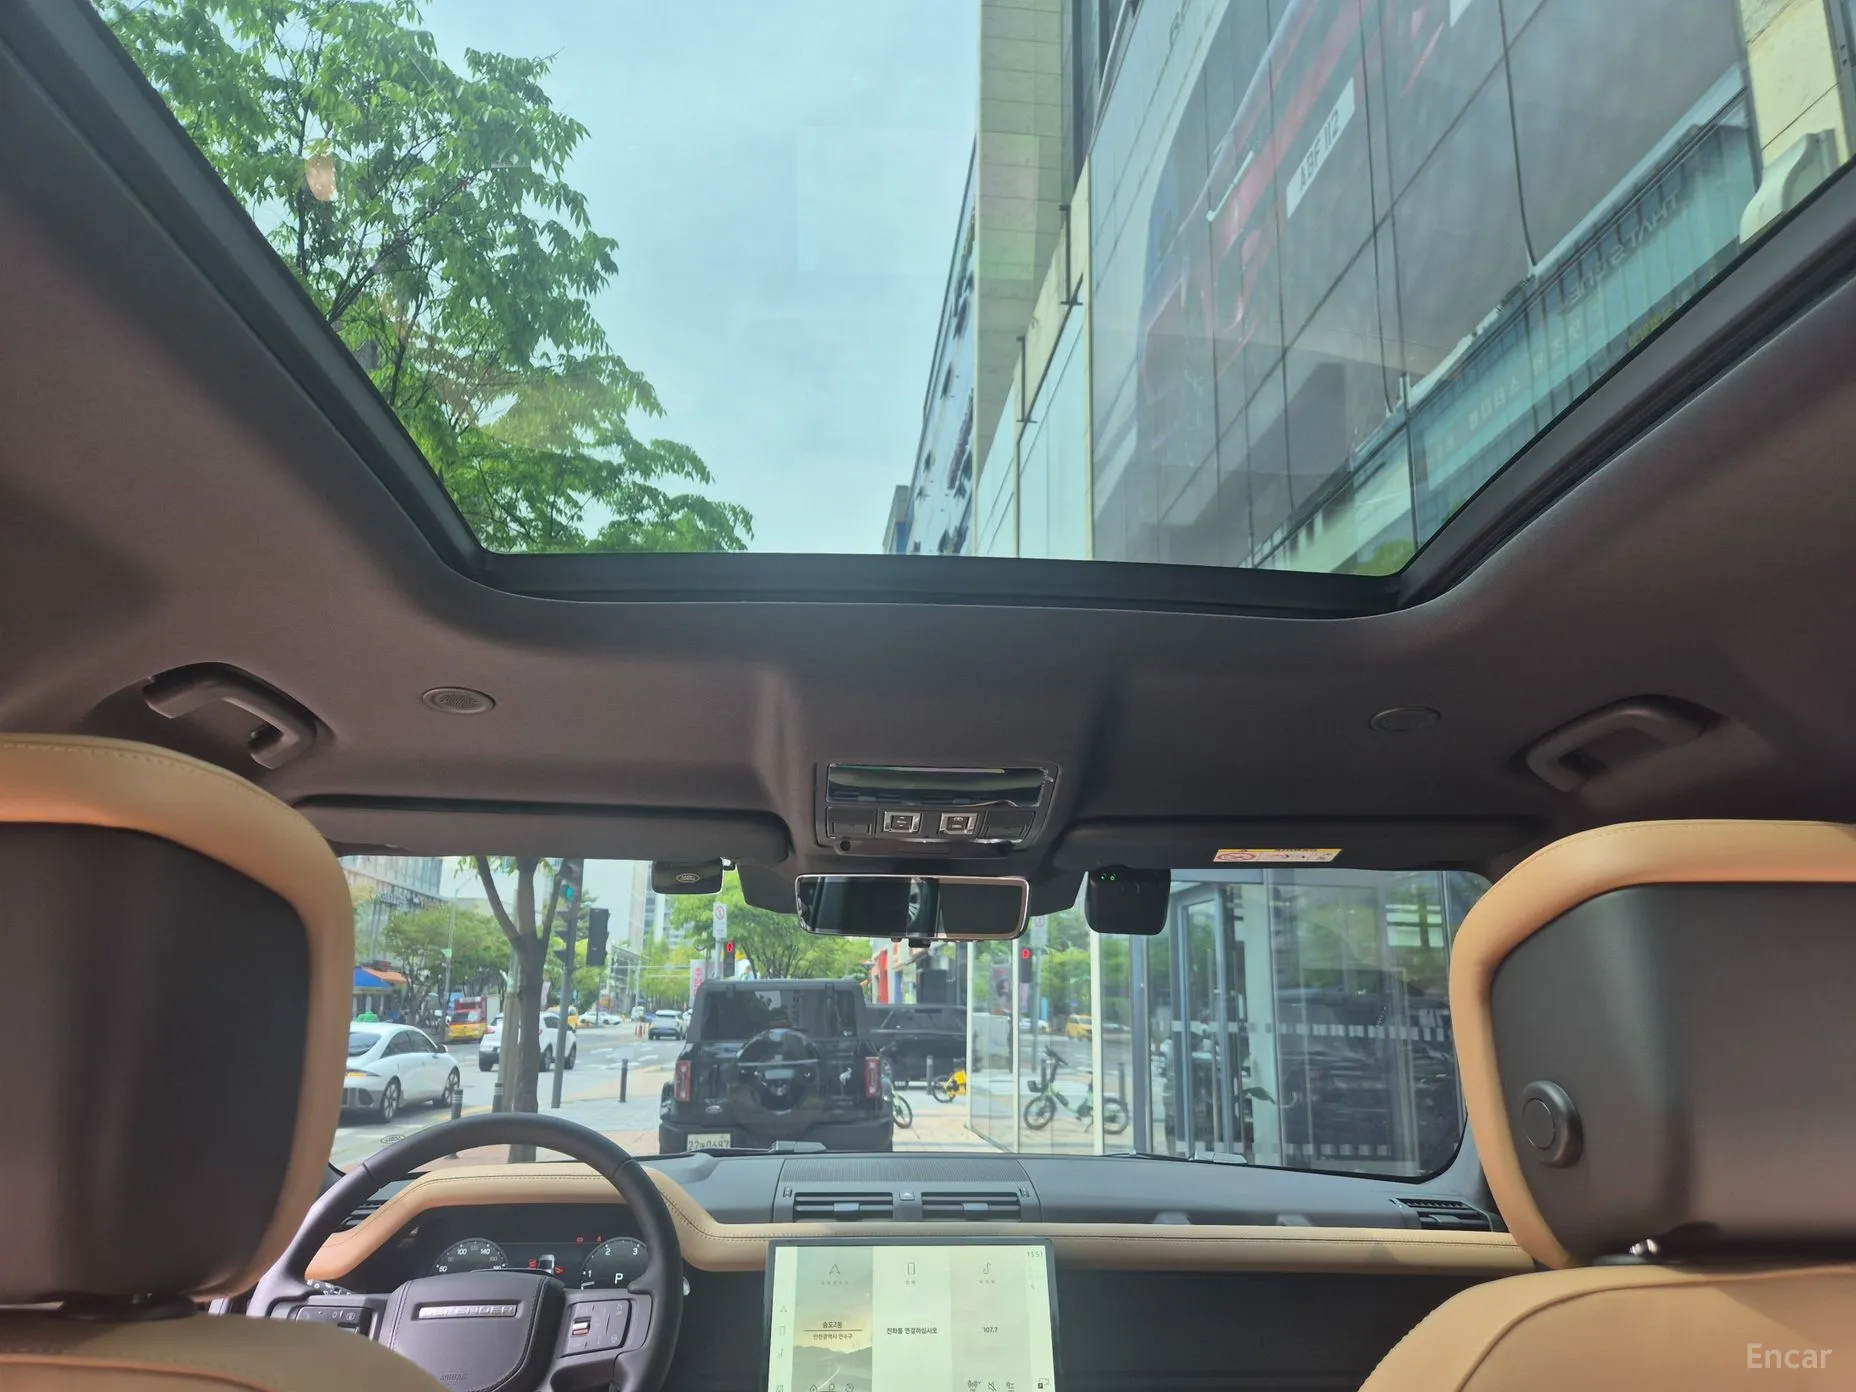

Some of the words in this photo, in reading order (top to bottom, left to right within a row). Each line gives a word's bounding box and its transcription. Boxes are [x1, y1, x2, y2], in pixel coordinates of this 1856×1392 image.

[456, 1248, 468, 1256] 100
[480, 1248, 491, 1256] 140
[604, 1247, 611, 1256] 2
[632, 1247, 638, 1256] 3
[438, 1265, 448, 1273] 60
[587, 1269, 592, 1278] 1
[614, 1272, 624, 1285] P
[983, 1326, 998, 1334] 107.7
